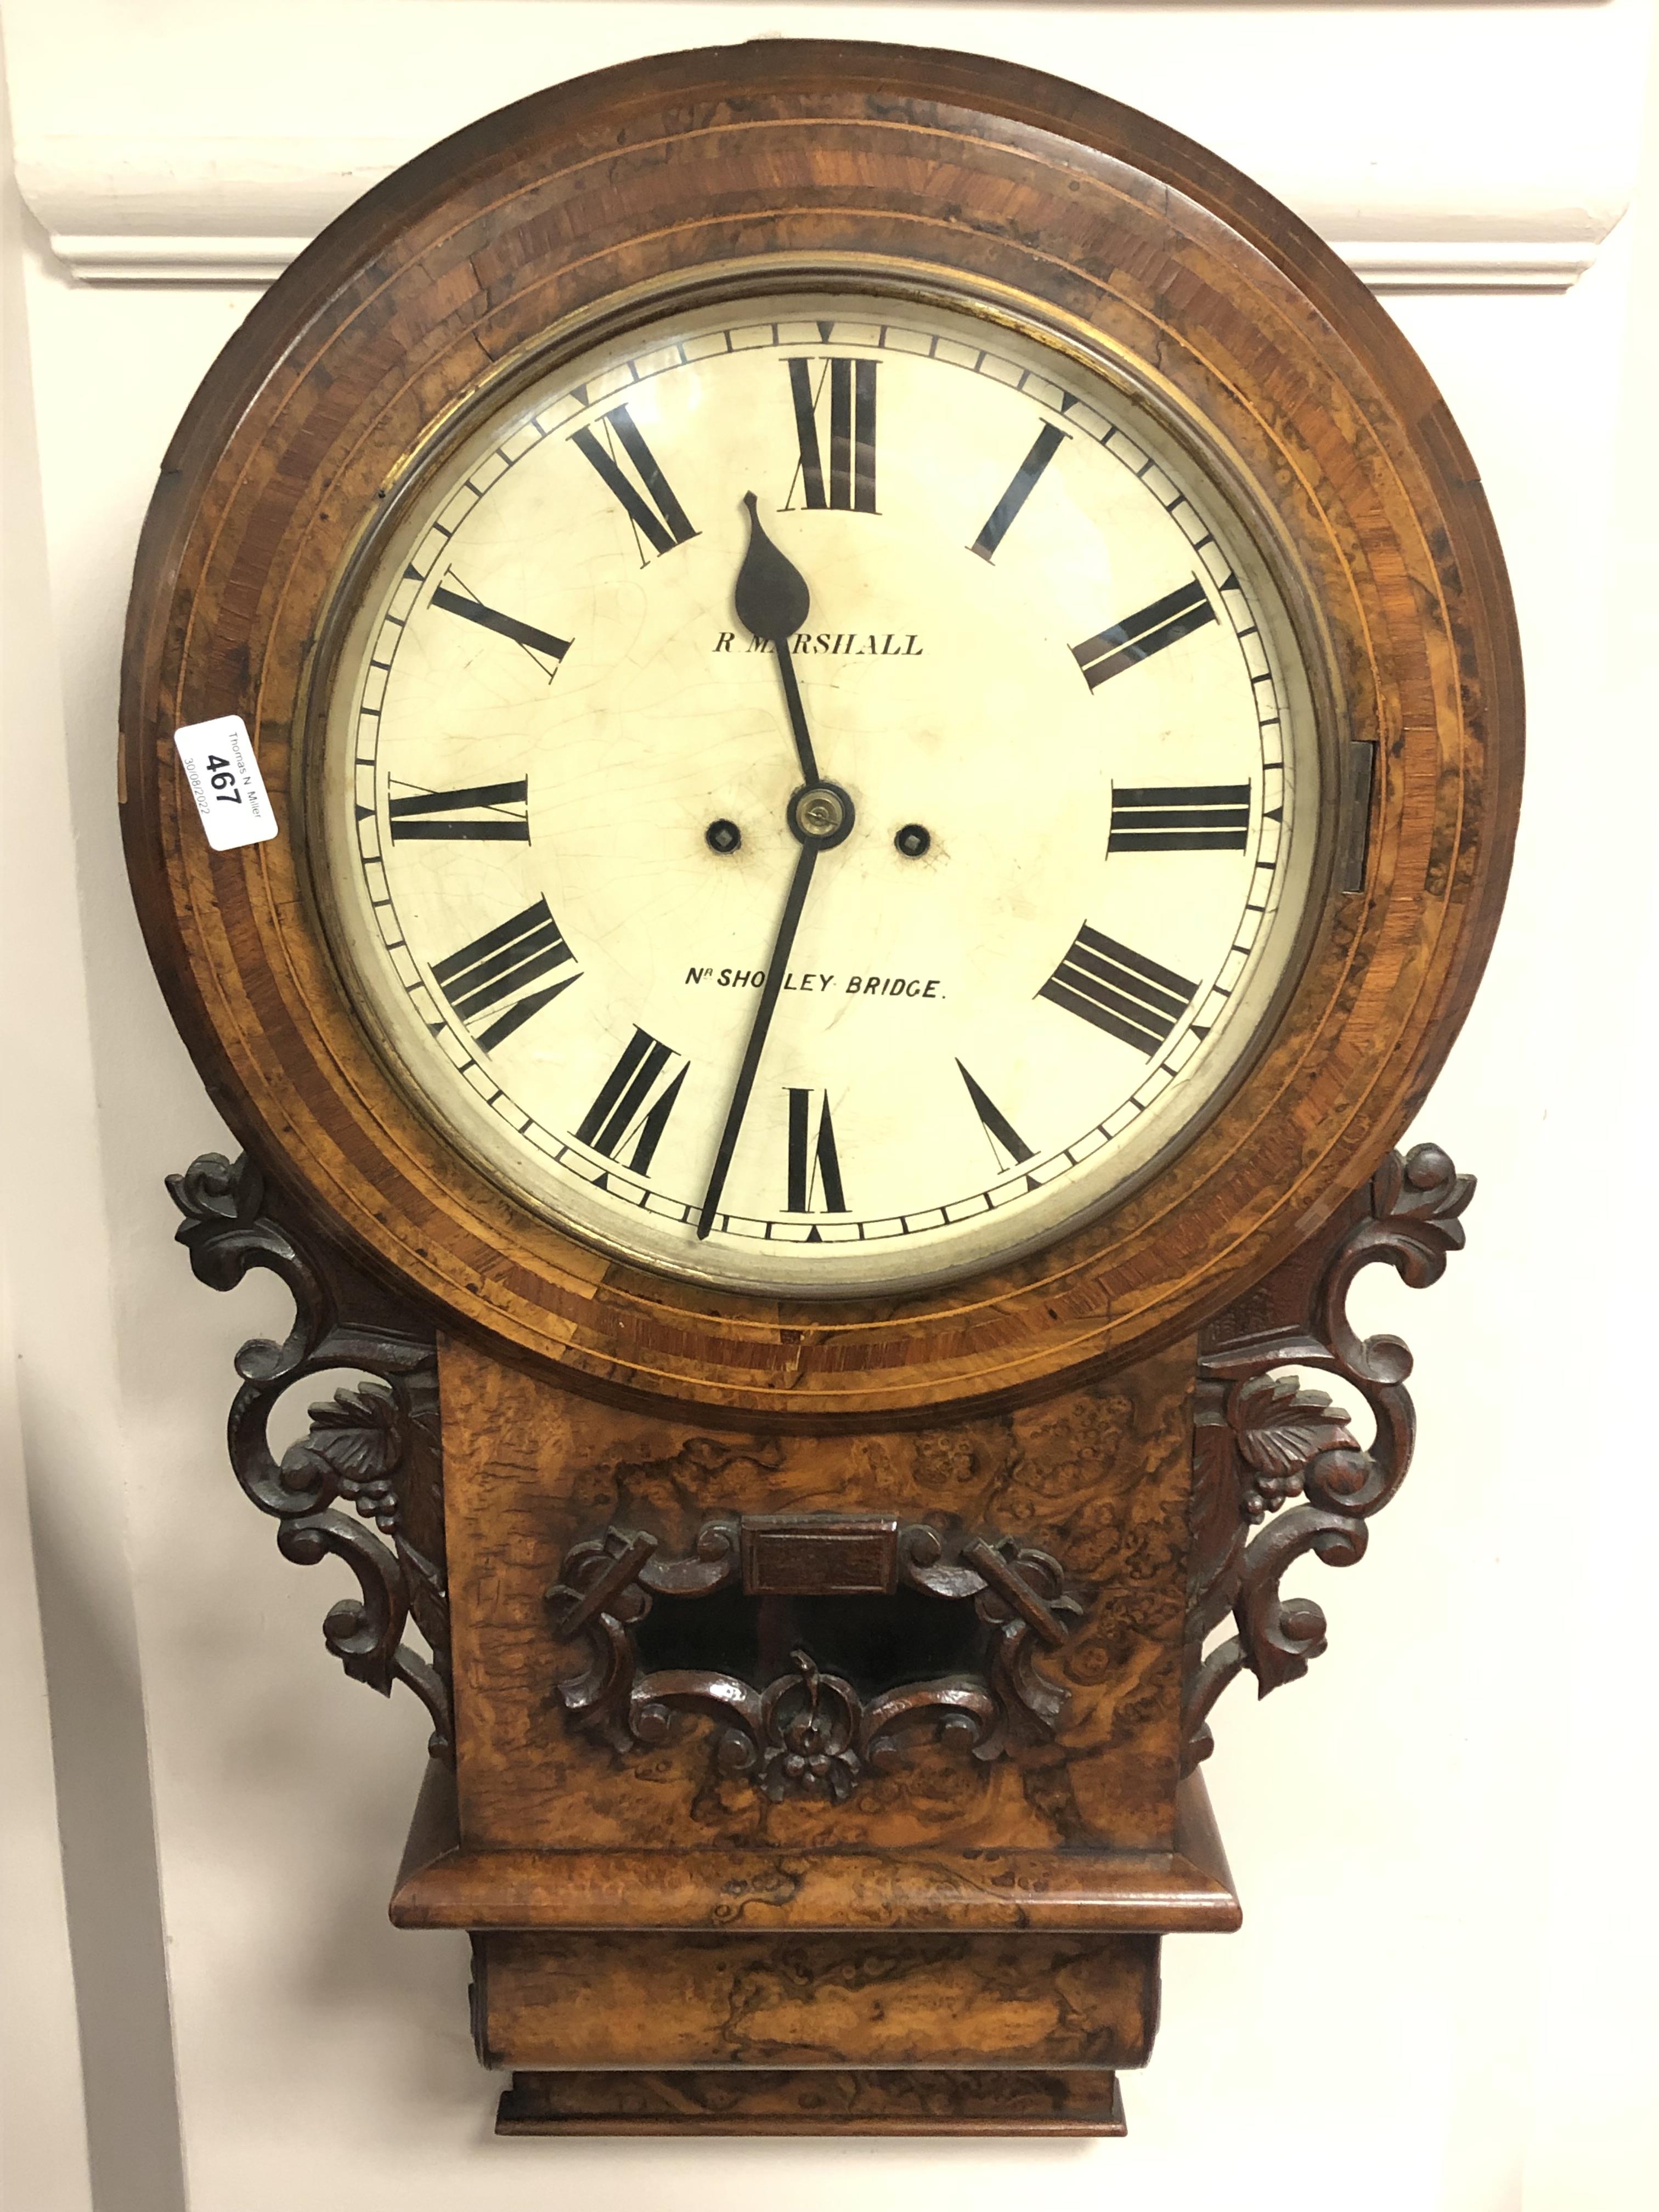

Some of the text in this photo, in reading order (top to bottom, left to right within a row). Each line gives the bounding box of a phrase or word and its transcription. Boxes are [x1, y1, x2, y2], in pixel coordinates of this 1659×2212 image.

[565, 402, 703, 569] XI
[777, 357, 883, 515] XII
[964, 417, 1074, 567] I
[426, 563, 575, 685] X
[745, 633, 923, 656] MRSHALL
[1066, 571, 1221, 696] II
[184, 758, 210, 814] 30/08/2022
[206, 755, 242, 804] 467
[229, 732, 261, 817] Thomas N Miller
[388, 771, 531, 847] IX
[1105, 777, 1252, 861] III
[427, 891, 584, 1062] VIII
[717, 968, 835, 992] SHOLEY
[845, 976, 946, 999] BRIDGE.
[1031, 919, 1204, 1065] IIII
[566, 1023, 691, 1179] VII
[780, 1086, 853, 1214] VI
[955, 1057, 1042, 1175] V
